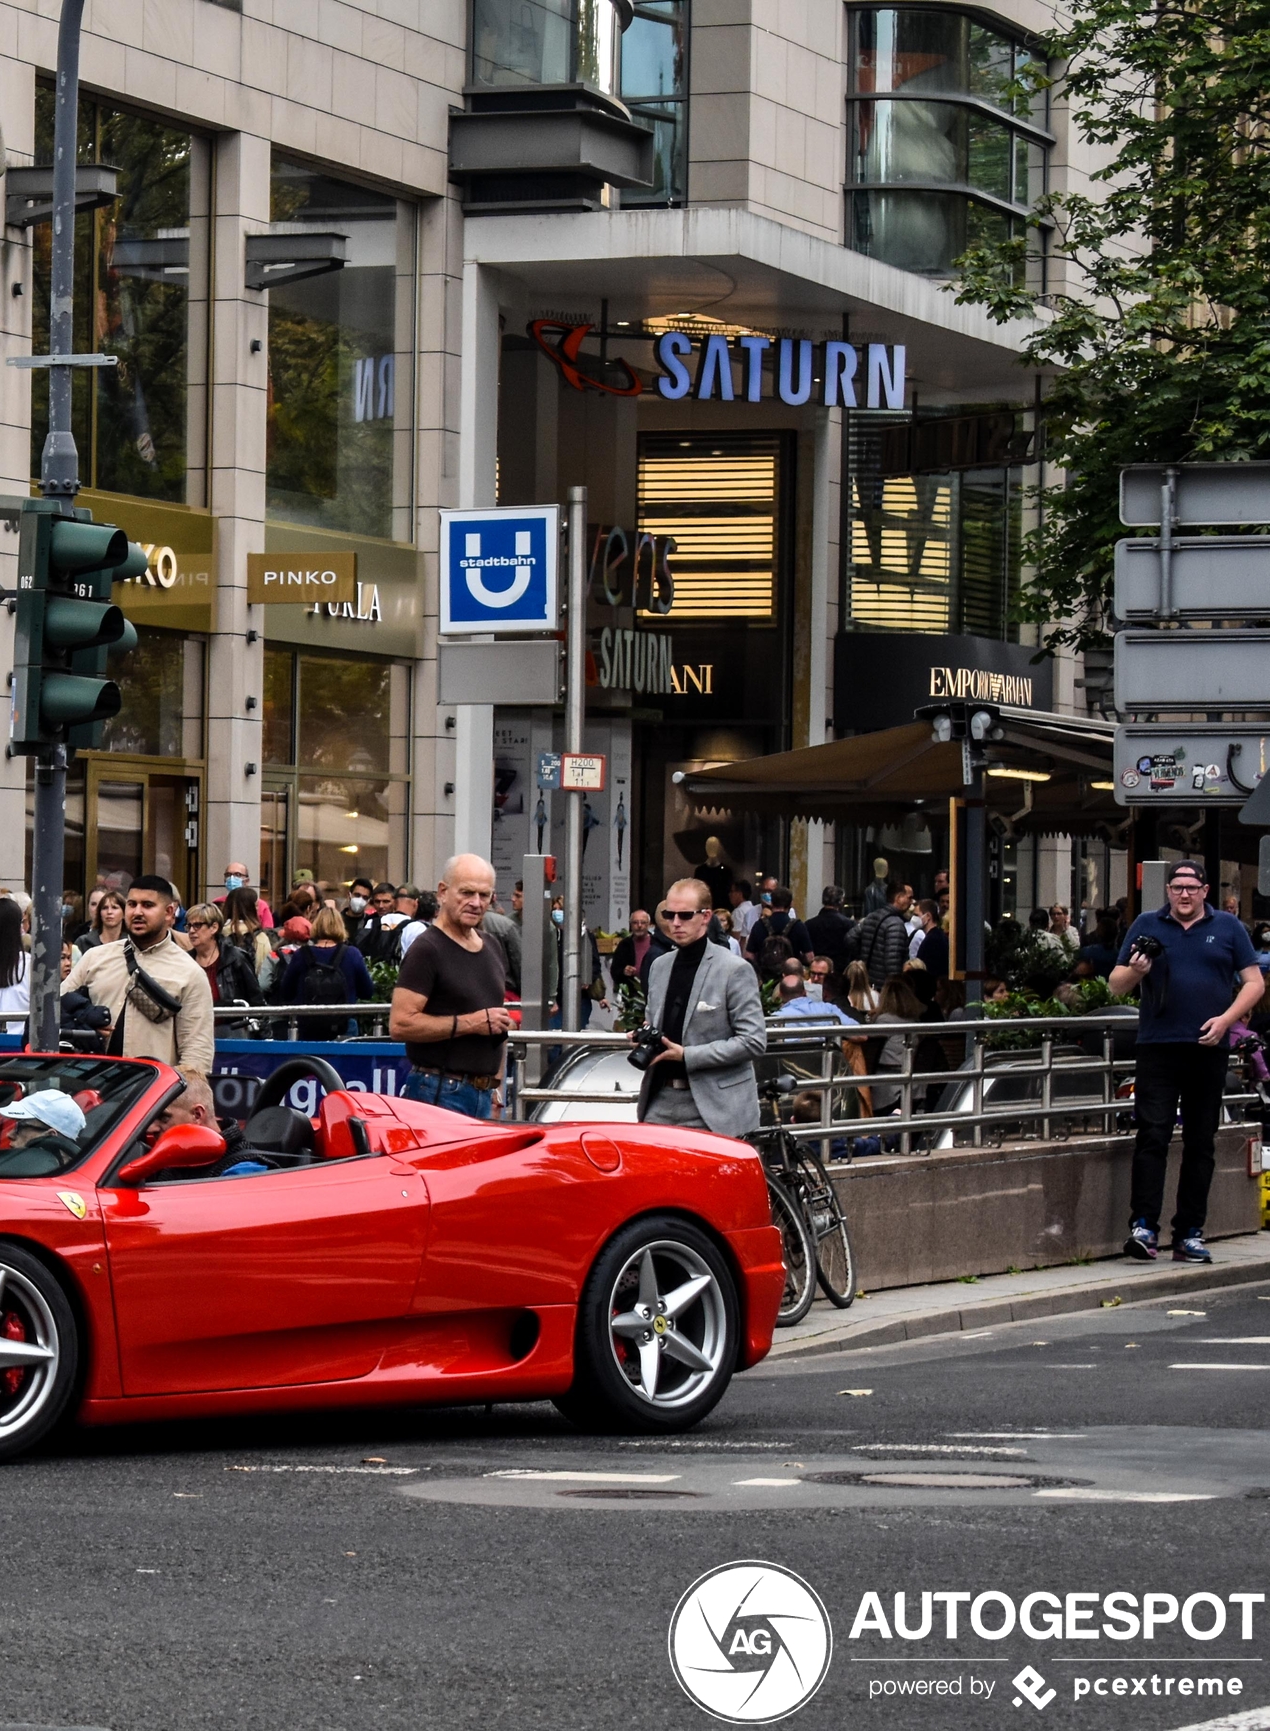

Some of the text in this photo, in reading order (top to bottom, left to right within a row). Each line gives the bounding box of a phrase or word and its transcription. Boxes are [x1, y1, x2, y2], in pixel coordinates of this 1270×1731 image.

[656, 331, 906, 410] SATURN
[459, 556, 536, 568] stadtbahn
[264, 570, 337, 586] PINKO
[599, 626, 673, 694] SATURN
[929, 666, 1032, 706] EMPORIO ARMANI
[571, 758, 594, 766] H200
